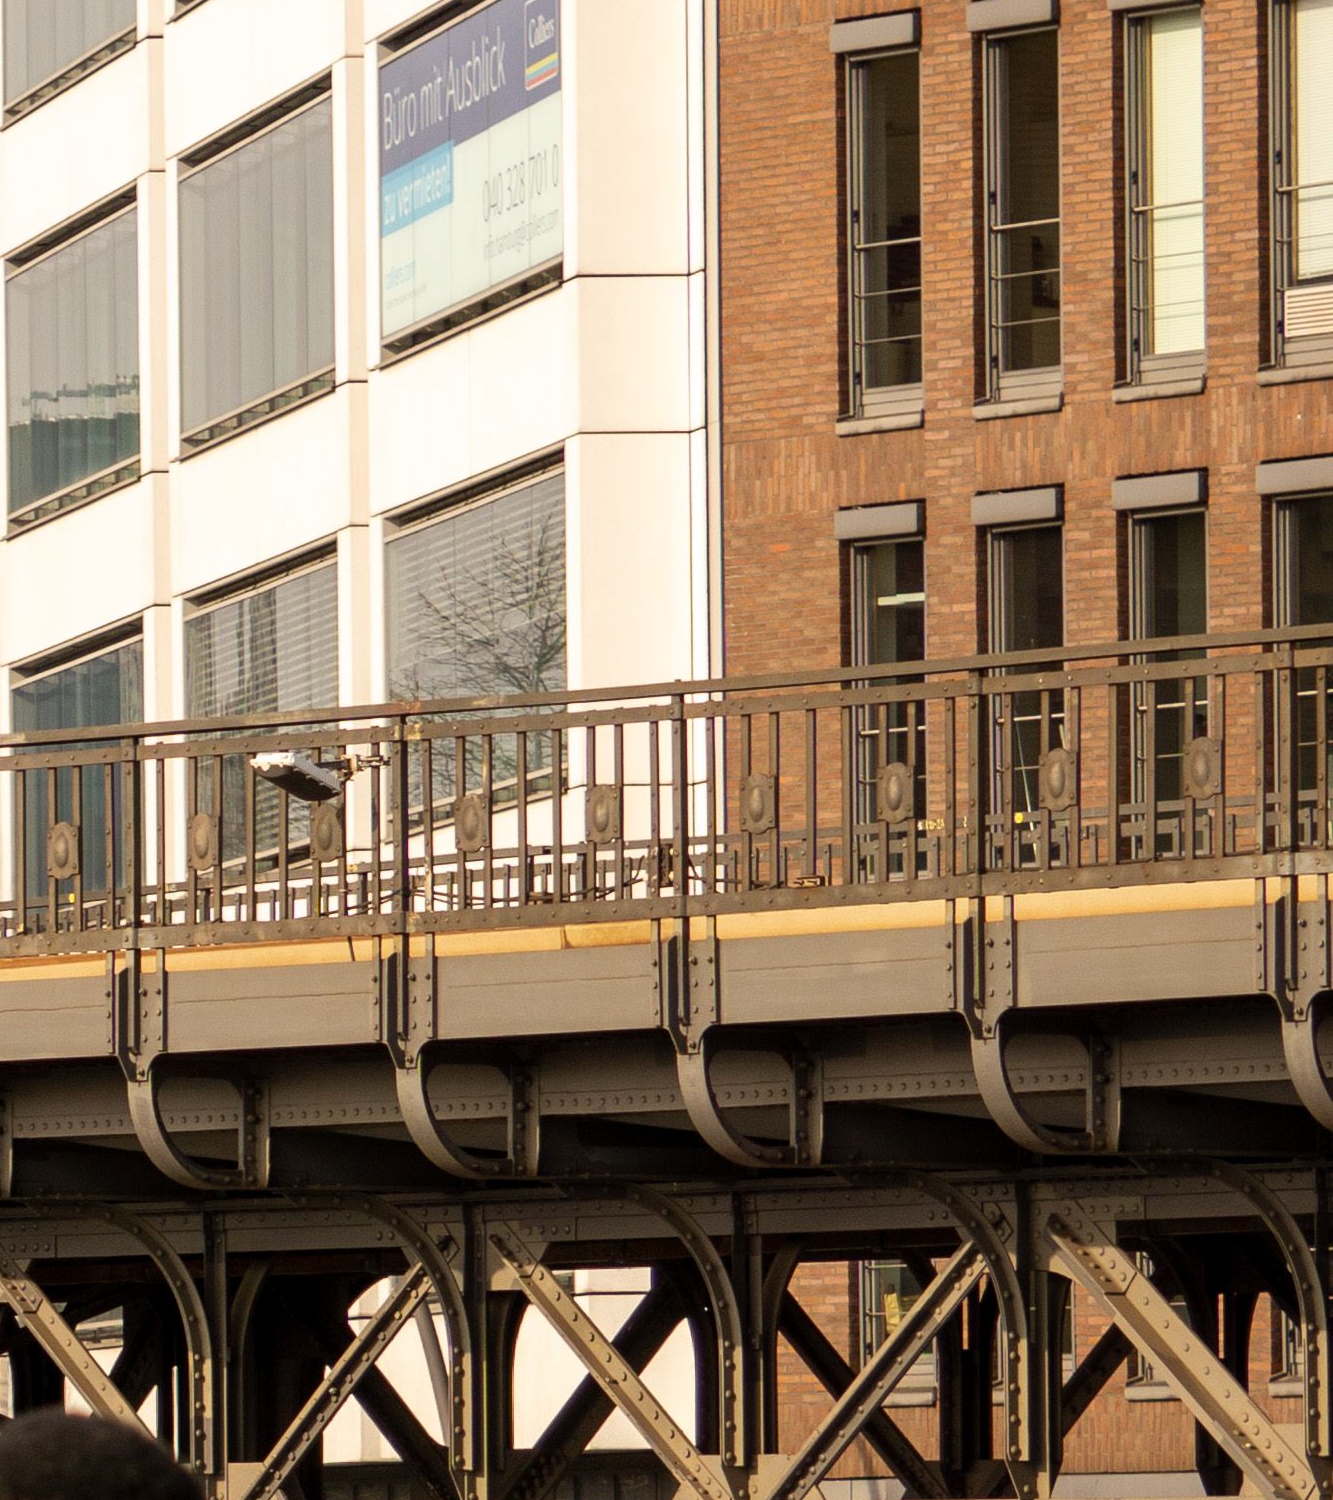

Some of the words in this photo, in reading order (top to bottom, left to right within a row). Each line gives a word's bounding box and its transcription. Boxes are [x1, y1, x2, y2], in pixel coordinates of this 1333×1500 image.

[383, 86, 417, 150] Büro
[420, 65, 443, 131] mit
[445, 25, 507, 117] Ausblick
[397, 153, 451, 218] vermieten!
